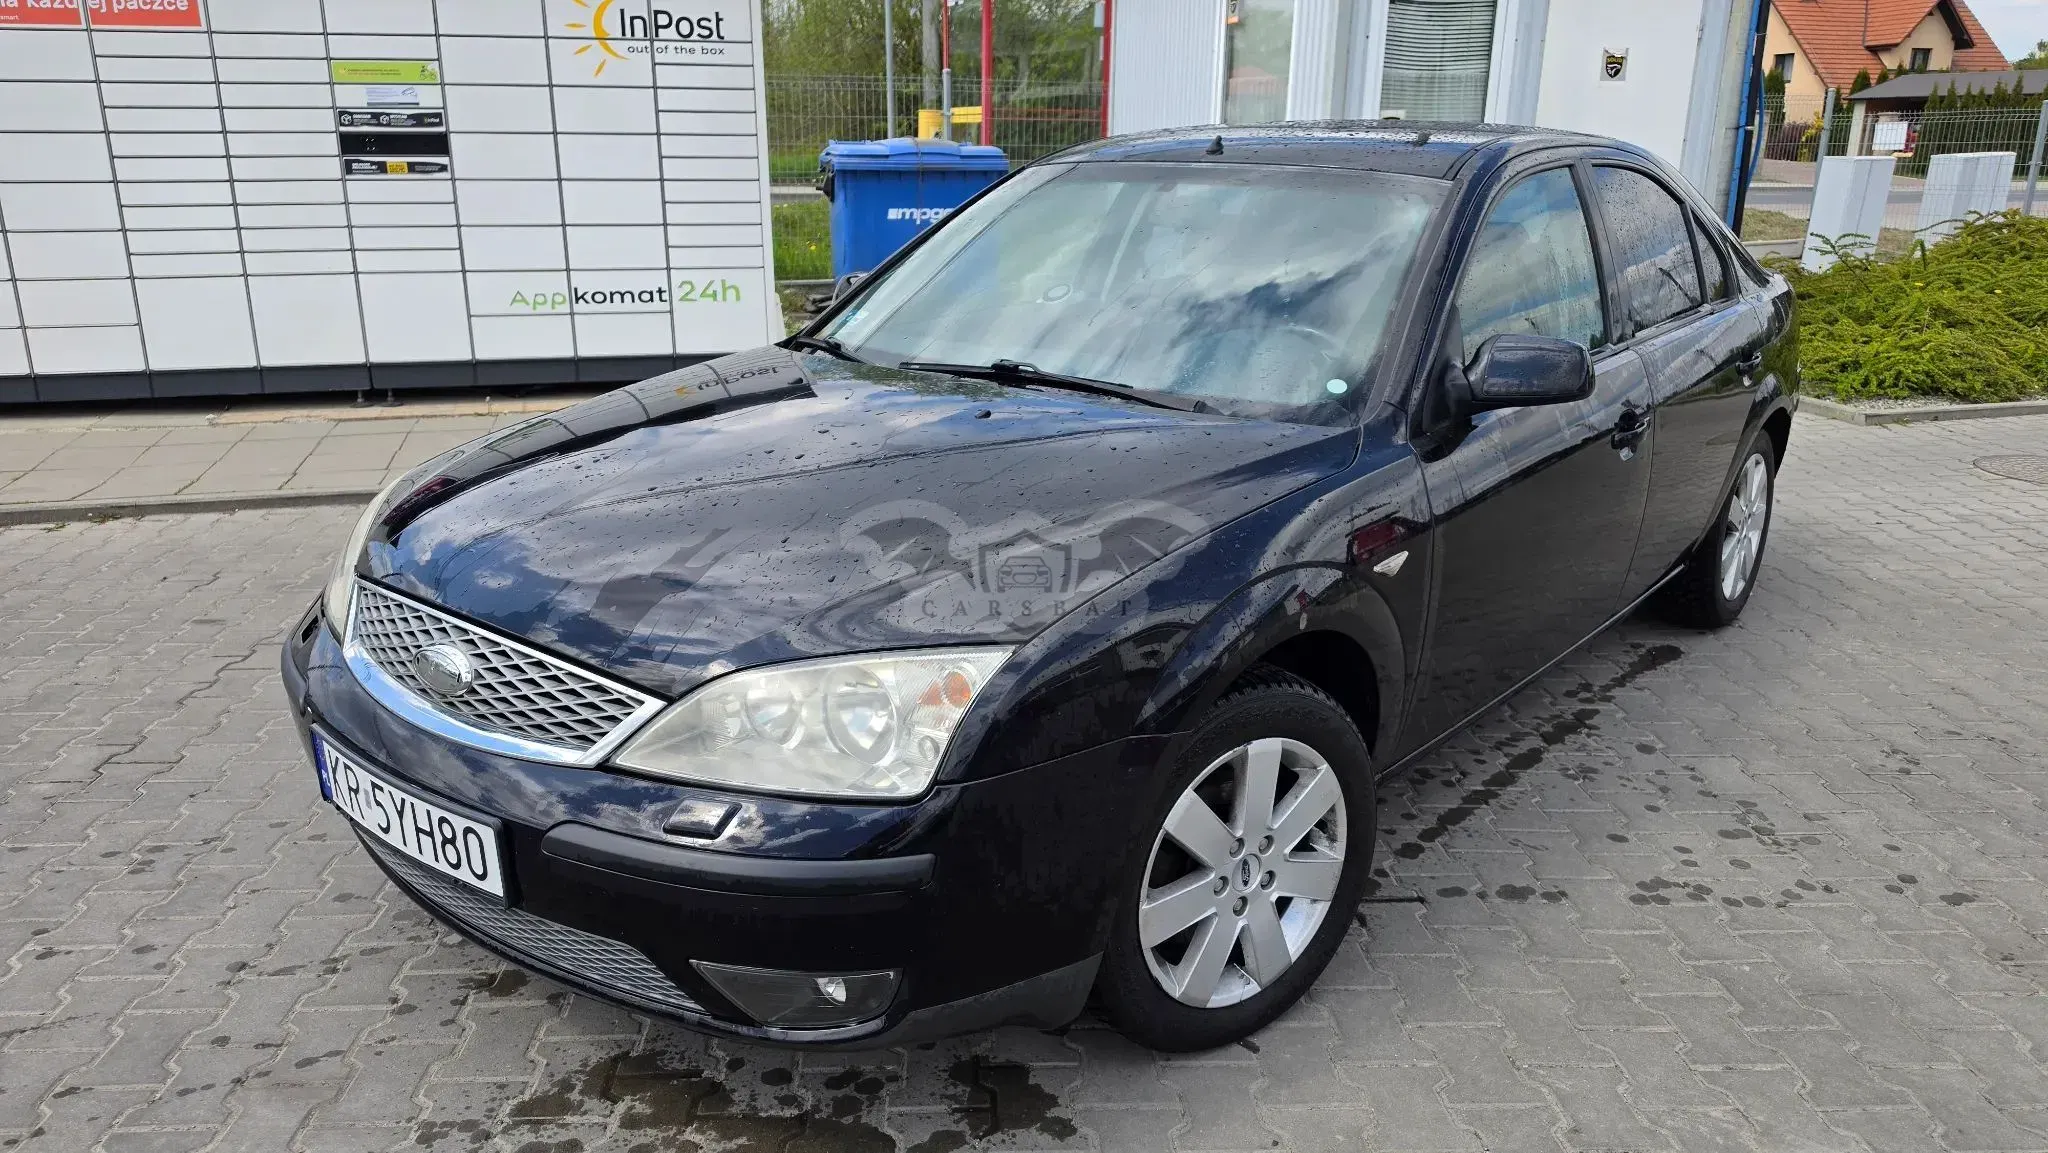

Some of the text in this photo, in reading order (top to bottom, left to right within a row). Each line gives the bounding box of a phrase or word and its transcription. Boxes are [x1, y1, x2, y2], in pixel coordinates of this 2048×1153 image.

[619, 8, 725, 40] InPost
[627, 45, 725, 55] out of the box
[678, 279, 741, 302] 24h
[327, 748, 488, 882] KR 5YH80
